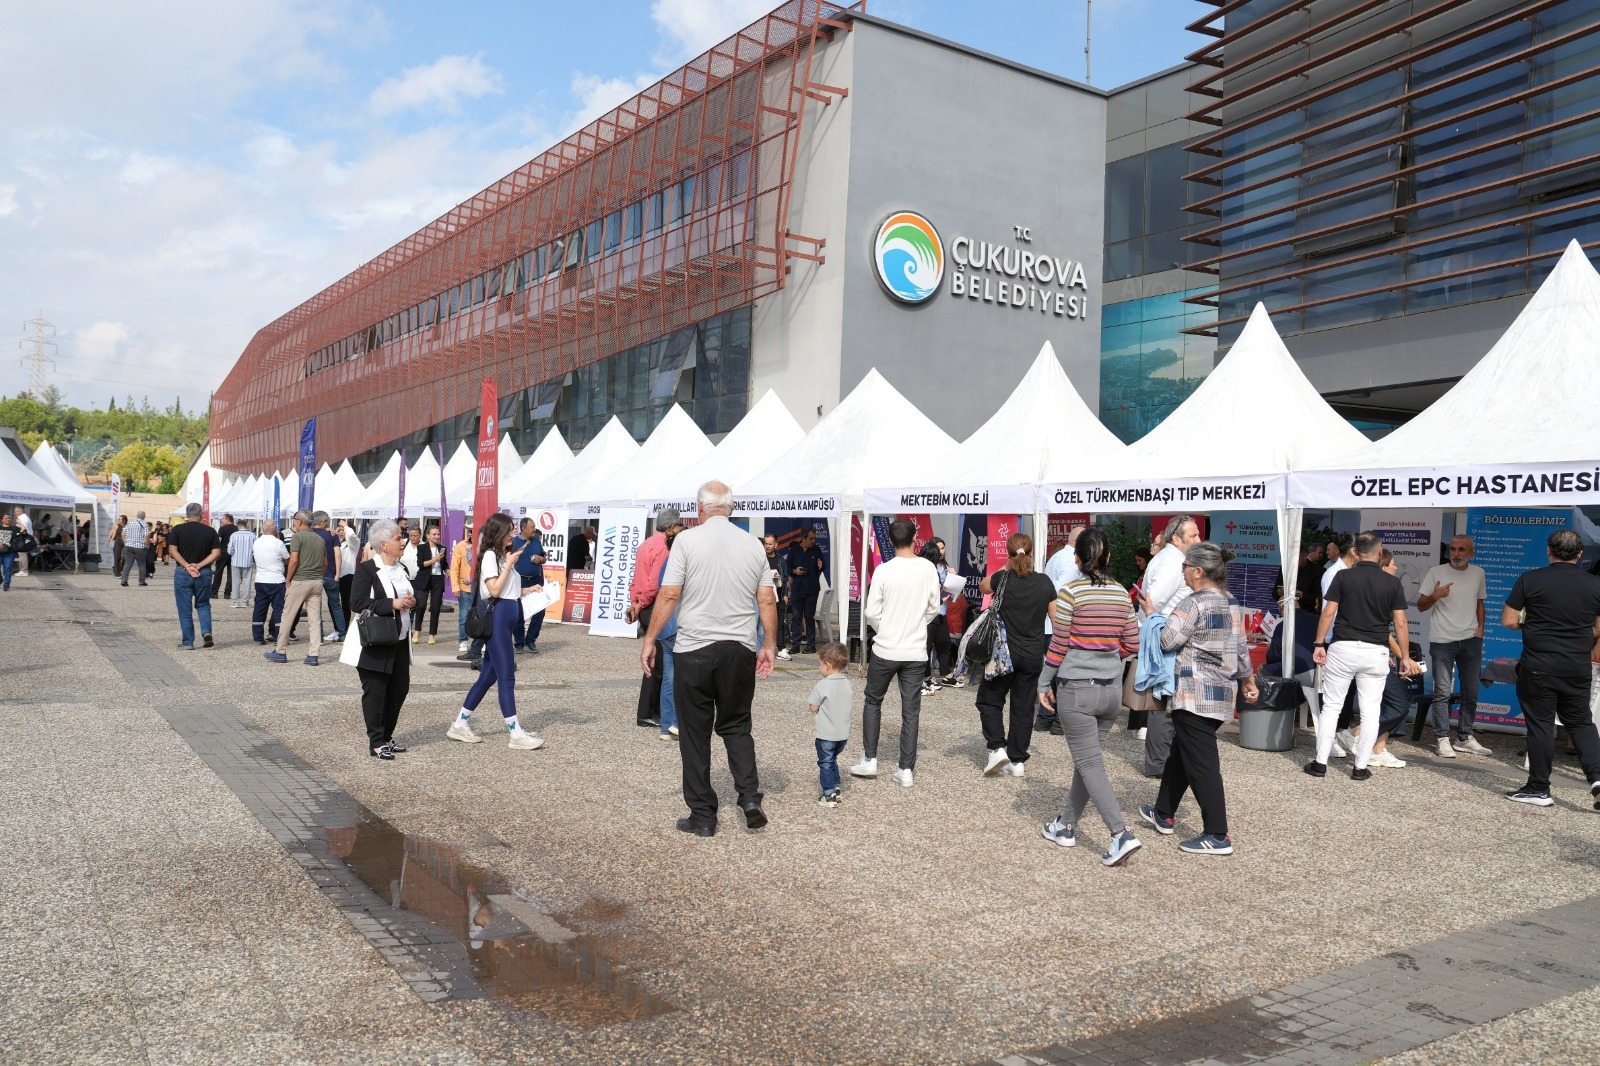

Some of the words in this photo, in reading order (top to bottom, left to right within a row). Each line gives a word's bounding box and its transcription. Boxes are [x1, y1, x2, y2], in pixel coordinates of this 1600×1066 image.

[951, 236, 1088, 290] ÇUKUROVA
[1351, 476, 1402, 496] ÖZEL
[1408, 477, 1450, 496] EPC
[1457, 467, 1600, 494] HASTANESİ
[900, 491, 950, 506] MEKTEBİM
[952, 490, 989, 506] KOLEJİ
[1054, 489, 1084, 504] ÖZEL
[1086, 487, 1174, 505] TÜRKMENBAŞI
[1178, 486, 1200, 502] TIP
[1203, 481, 1266, 500] MERKEZİ
[588, 505, 600, 514] GROS
[746, 498, 770, 510] KOLEJİ
[770, 500, 796, 510] ADANA
[798, 498, 834, 510] KAMPÜSÜ
[1484, 514, 1566, 526] BÖLÜMLERİMİZ
[542, 534, 564, 548] KAN
[1252, 542, 1276, 551] SERVİS
[598, 535, 616, 619] MEDICANA
[613, 576, 625, 620] EĞİTİM
[619, 525, 630, 571] GRUBU
[965, 576, 982, 586] GİR
[963, 588, 982, 598] KOL
